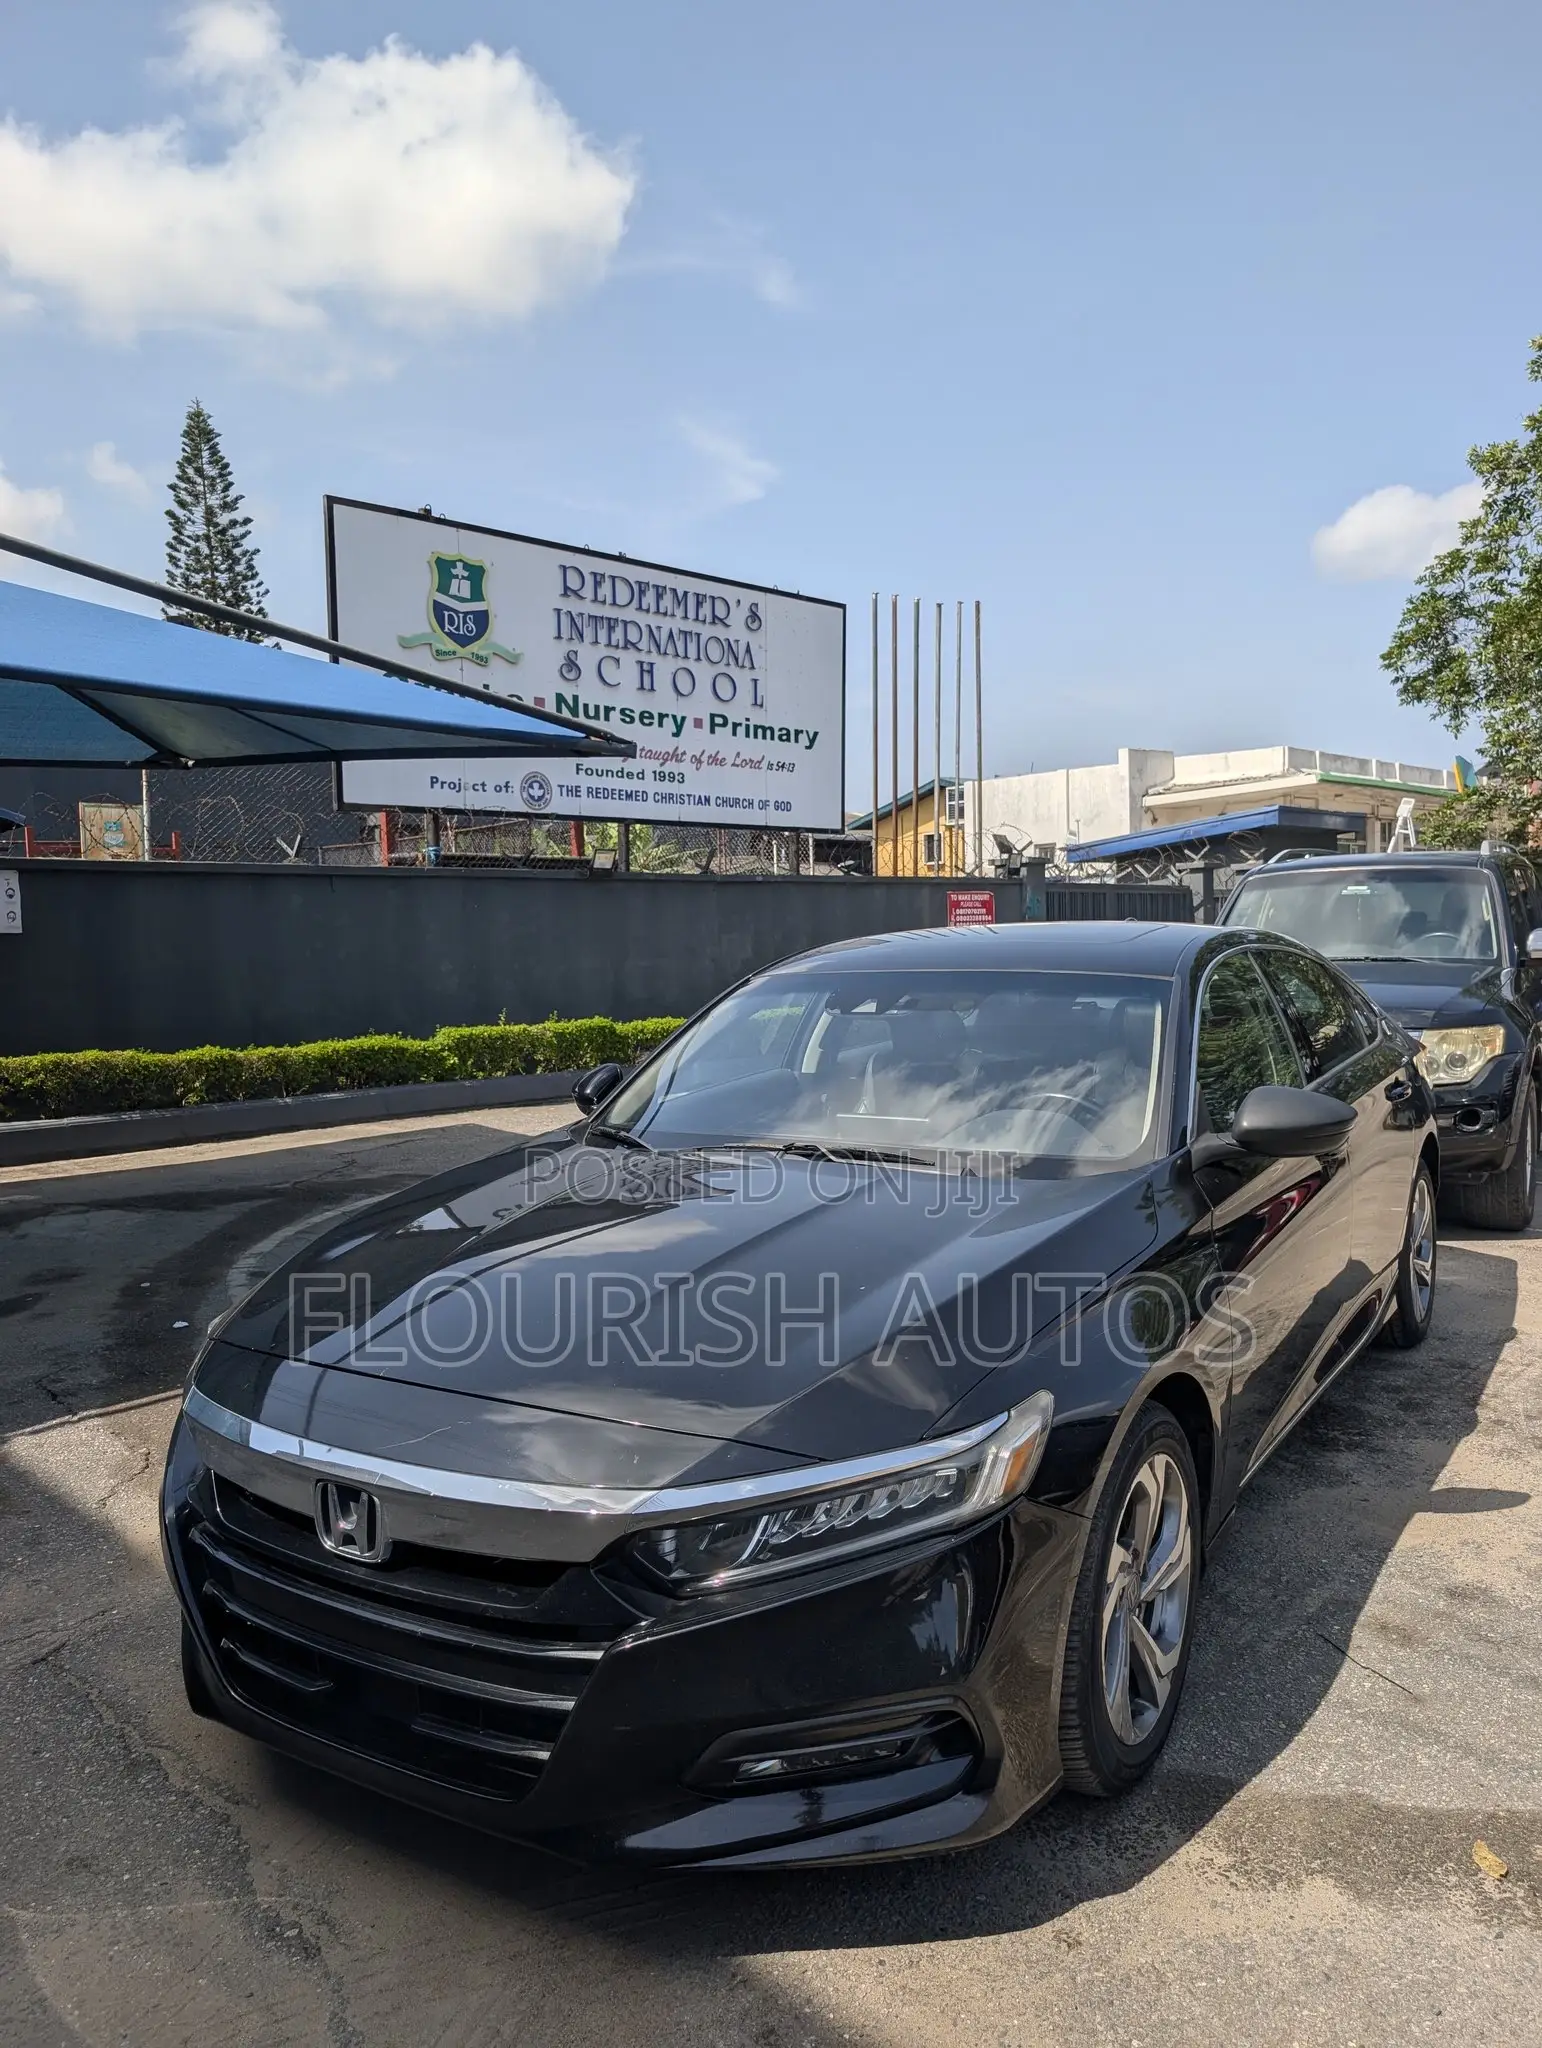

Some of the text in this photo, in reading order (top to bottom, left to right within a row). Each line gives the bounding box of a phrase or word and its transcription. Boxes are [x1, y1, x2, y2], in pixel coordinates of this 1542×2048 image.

[559, 564, 763, 632] REDEEMER'S
[443, 610, 476, 637] RIS
[553, 608, 756, 670] INTERNATIONA
[435, 649, 489, 664] Since 1993
[559, 650, 764, 709] SCHOOL
[555, 692, 820, 751] Nursery Primary
[638, 746, 687, 768] taught
[690, 749, 706, 771] of
[706, 750, 728, 767] the
[731, 751, 765, 771] Lord
[575, 763, 686, 784] Founded 1993
[557, 784, 582, 798] THE
[587, 786, 649, 803] REDEEMED
[653, 791, 711, 807] CHRISTIAN
[715, 795, 754, 811] CHURCH
[758, 799, 771, 811] OF
[773, 800, 792, 813] GOD
